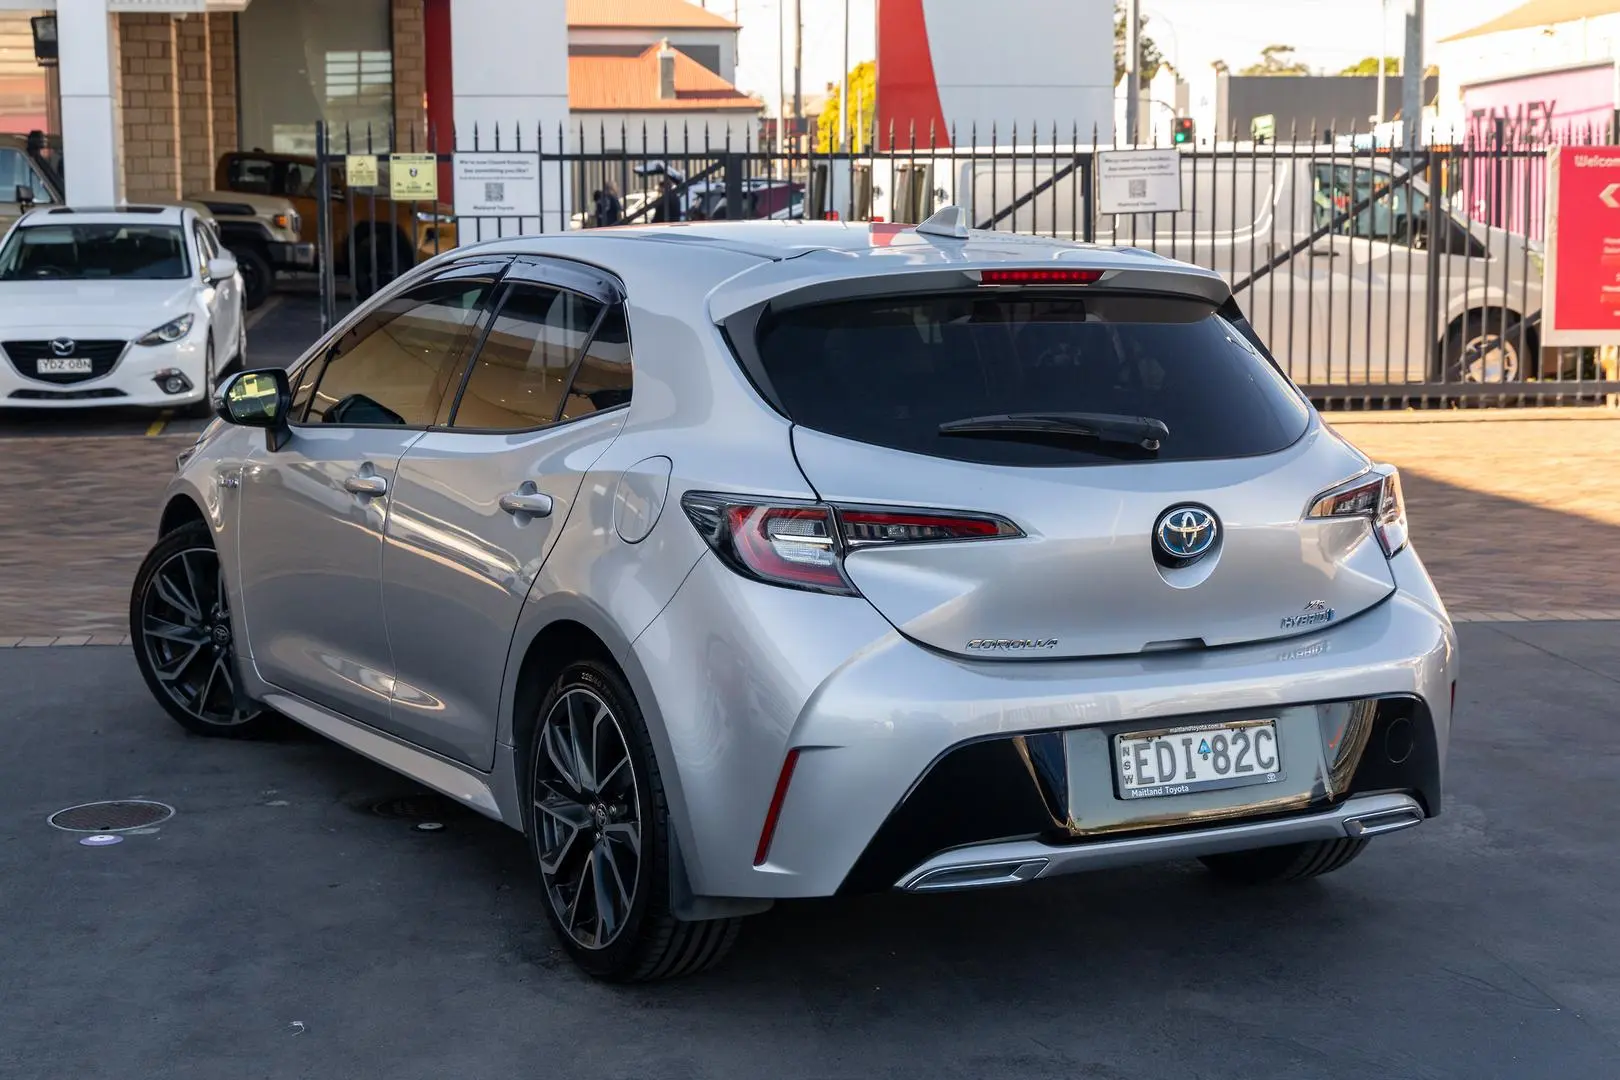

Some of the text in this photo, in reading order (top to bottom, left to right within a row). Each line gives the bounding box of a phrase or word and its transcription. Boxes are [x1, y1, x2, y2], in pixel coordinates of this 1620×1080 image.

[966, 639, 1058, 650] COROLLA
[1133, 728, 1275, 785] EDI 82C
[1131, 785, 1189, 797] Maitland Toyota
